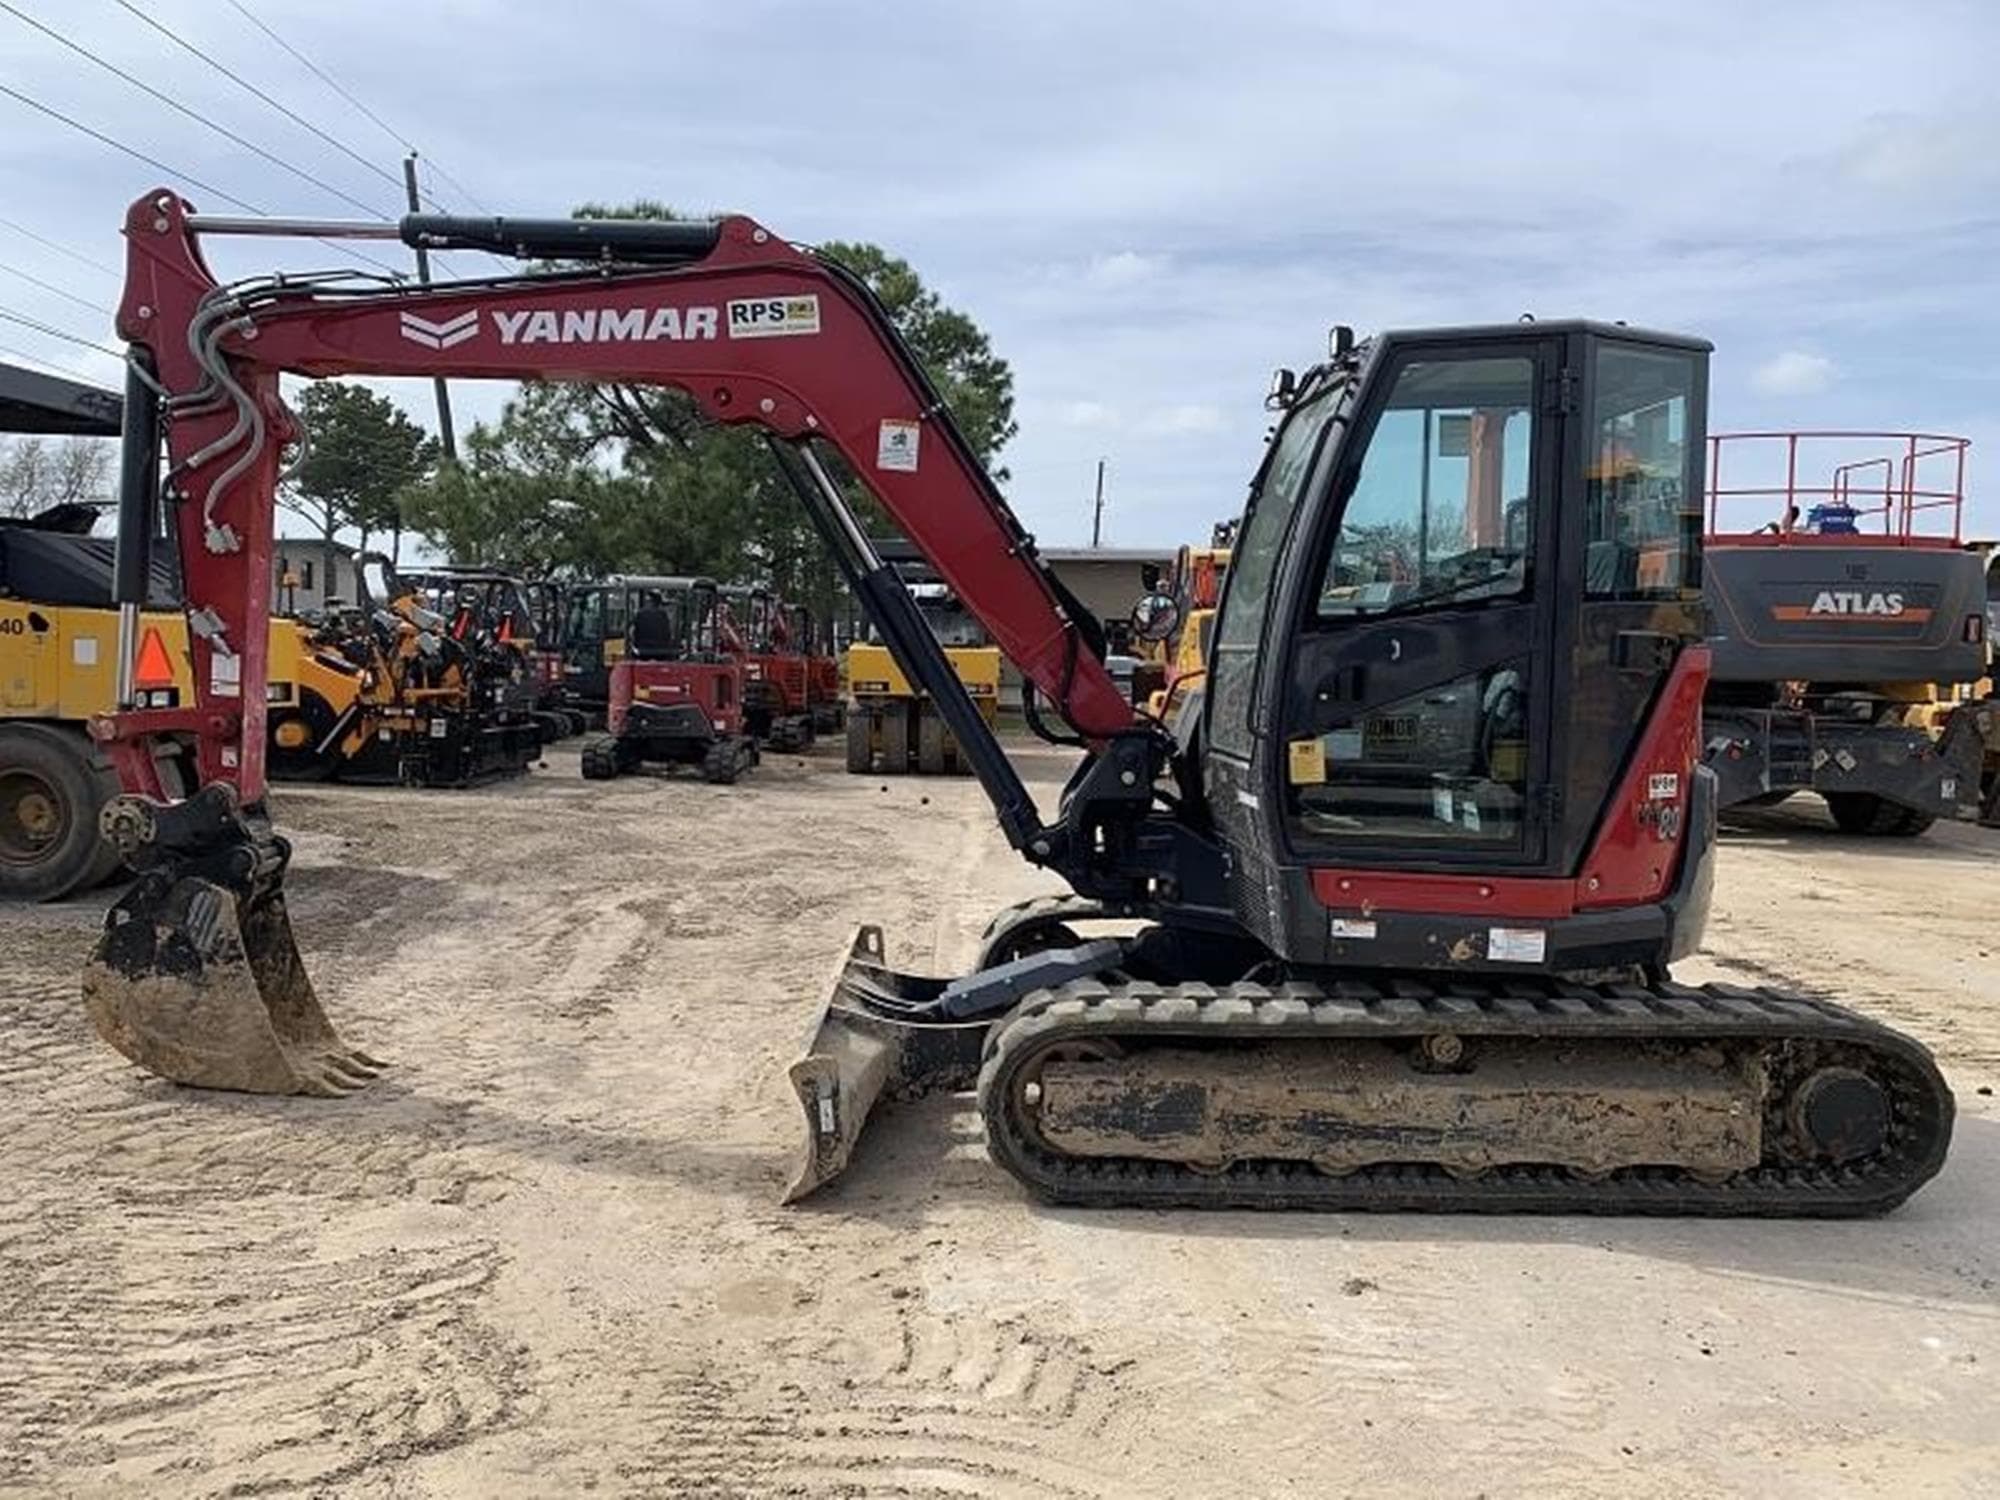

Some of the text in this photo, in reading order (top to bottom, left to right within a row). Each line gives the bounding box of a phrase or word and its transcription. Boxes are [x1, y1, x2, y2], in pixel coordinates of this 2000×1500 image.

[731, 301, 785, 324] RPS
[493, 307, 719, 345] YANMAR
[1811, 591, 1903, 616] ATLAS
[0, 618, 24, 635] 40
